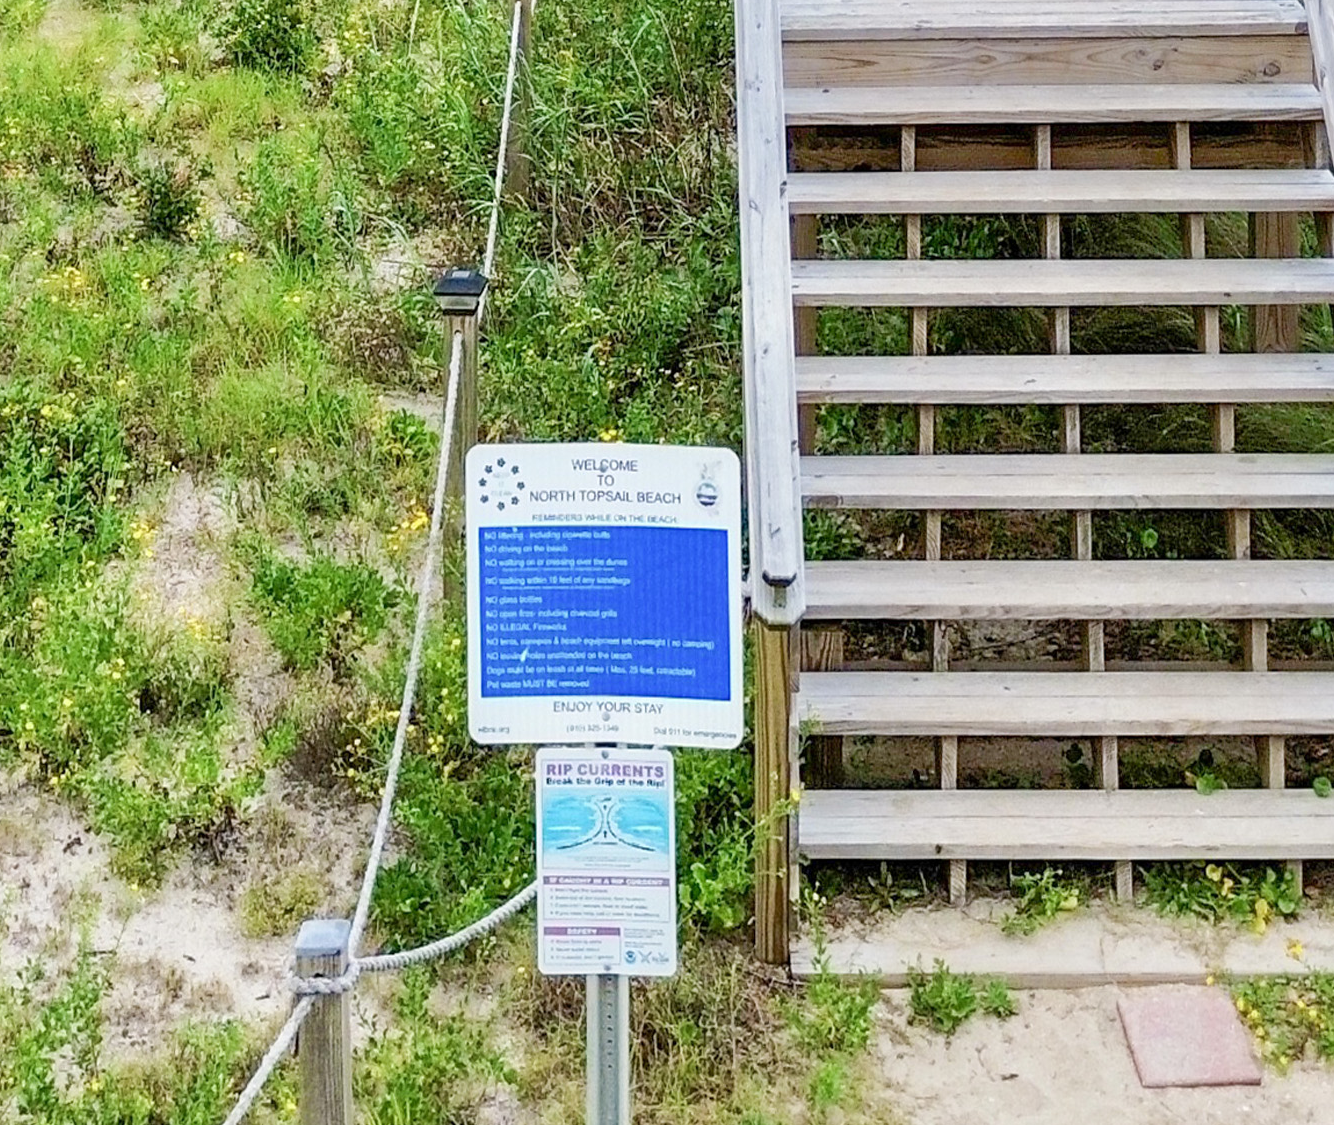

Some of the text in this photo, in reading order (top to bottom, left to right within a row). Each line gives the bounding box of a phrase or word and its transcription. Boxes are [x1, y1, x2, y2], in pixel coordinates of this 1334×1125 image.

[571, 459, 638, 472] WELCOME
[597, 475, 614, 487] TO
[529, 490, 682, 504] NORTH TOPSAIL BEACH
[647, 515, 677, 523] BEACH
[484, 532, 496, 540] NO
[484, 545, 497, 553] NO
[485, 559, 497, 567] NO
[485, 577, 497, 585] NO
[485, 596, 498, 604] NO
[486, 610, 498, 618] NO
[486, 638, 499, 646] NO
[486, 652, 499, 660] NO
[553, 701, 664, 714] ENJOY YOUR STAY
[546, 764, 665, 778] RIP CURRENTS
[546, 777, 573, 786] Break
[576, 777, 591, 785] the
[594, 777, 614, 787] Grip
[629, 778, 644, 787] the
